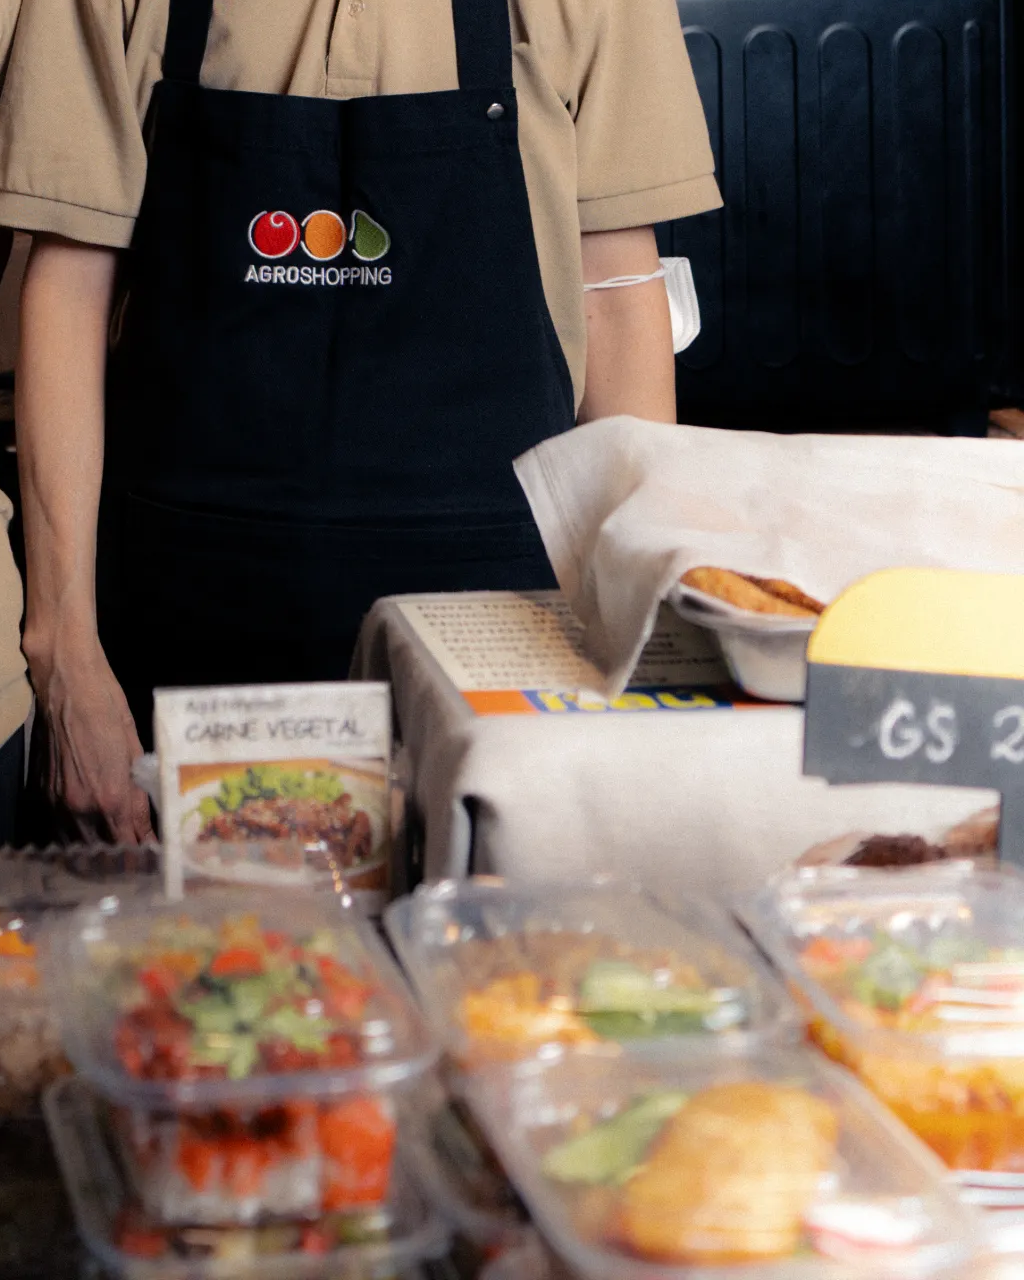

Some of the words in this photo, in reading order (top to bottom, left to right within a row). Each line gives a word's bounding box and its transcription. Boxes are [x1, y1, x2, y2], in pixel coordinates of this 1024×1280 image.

[244, 264, 392, 286] AGROSHOPPING
[185, 719, 258, 743] CARNE
[266, 716, 366, 741] VEGETAL
[879, 698, 958, 764] GS
